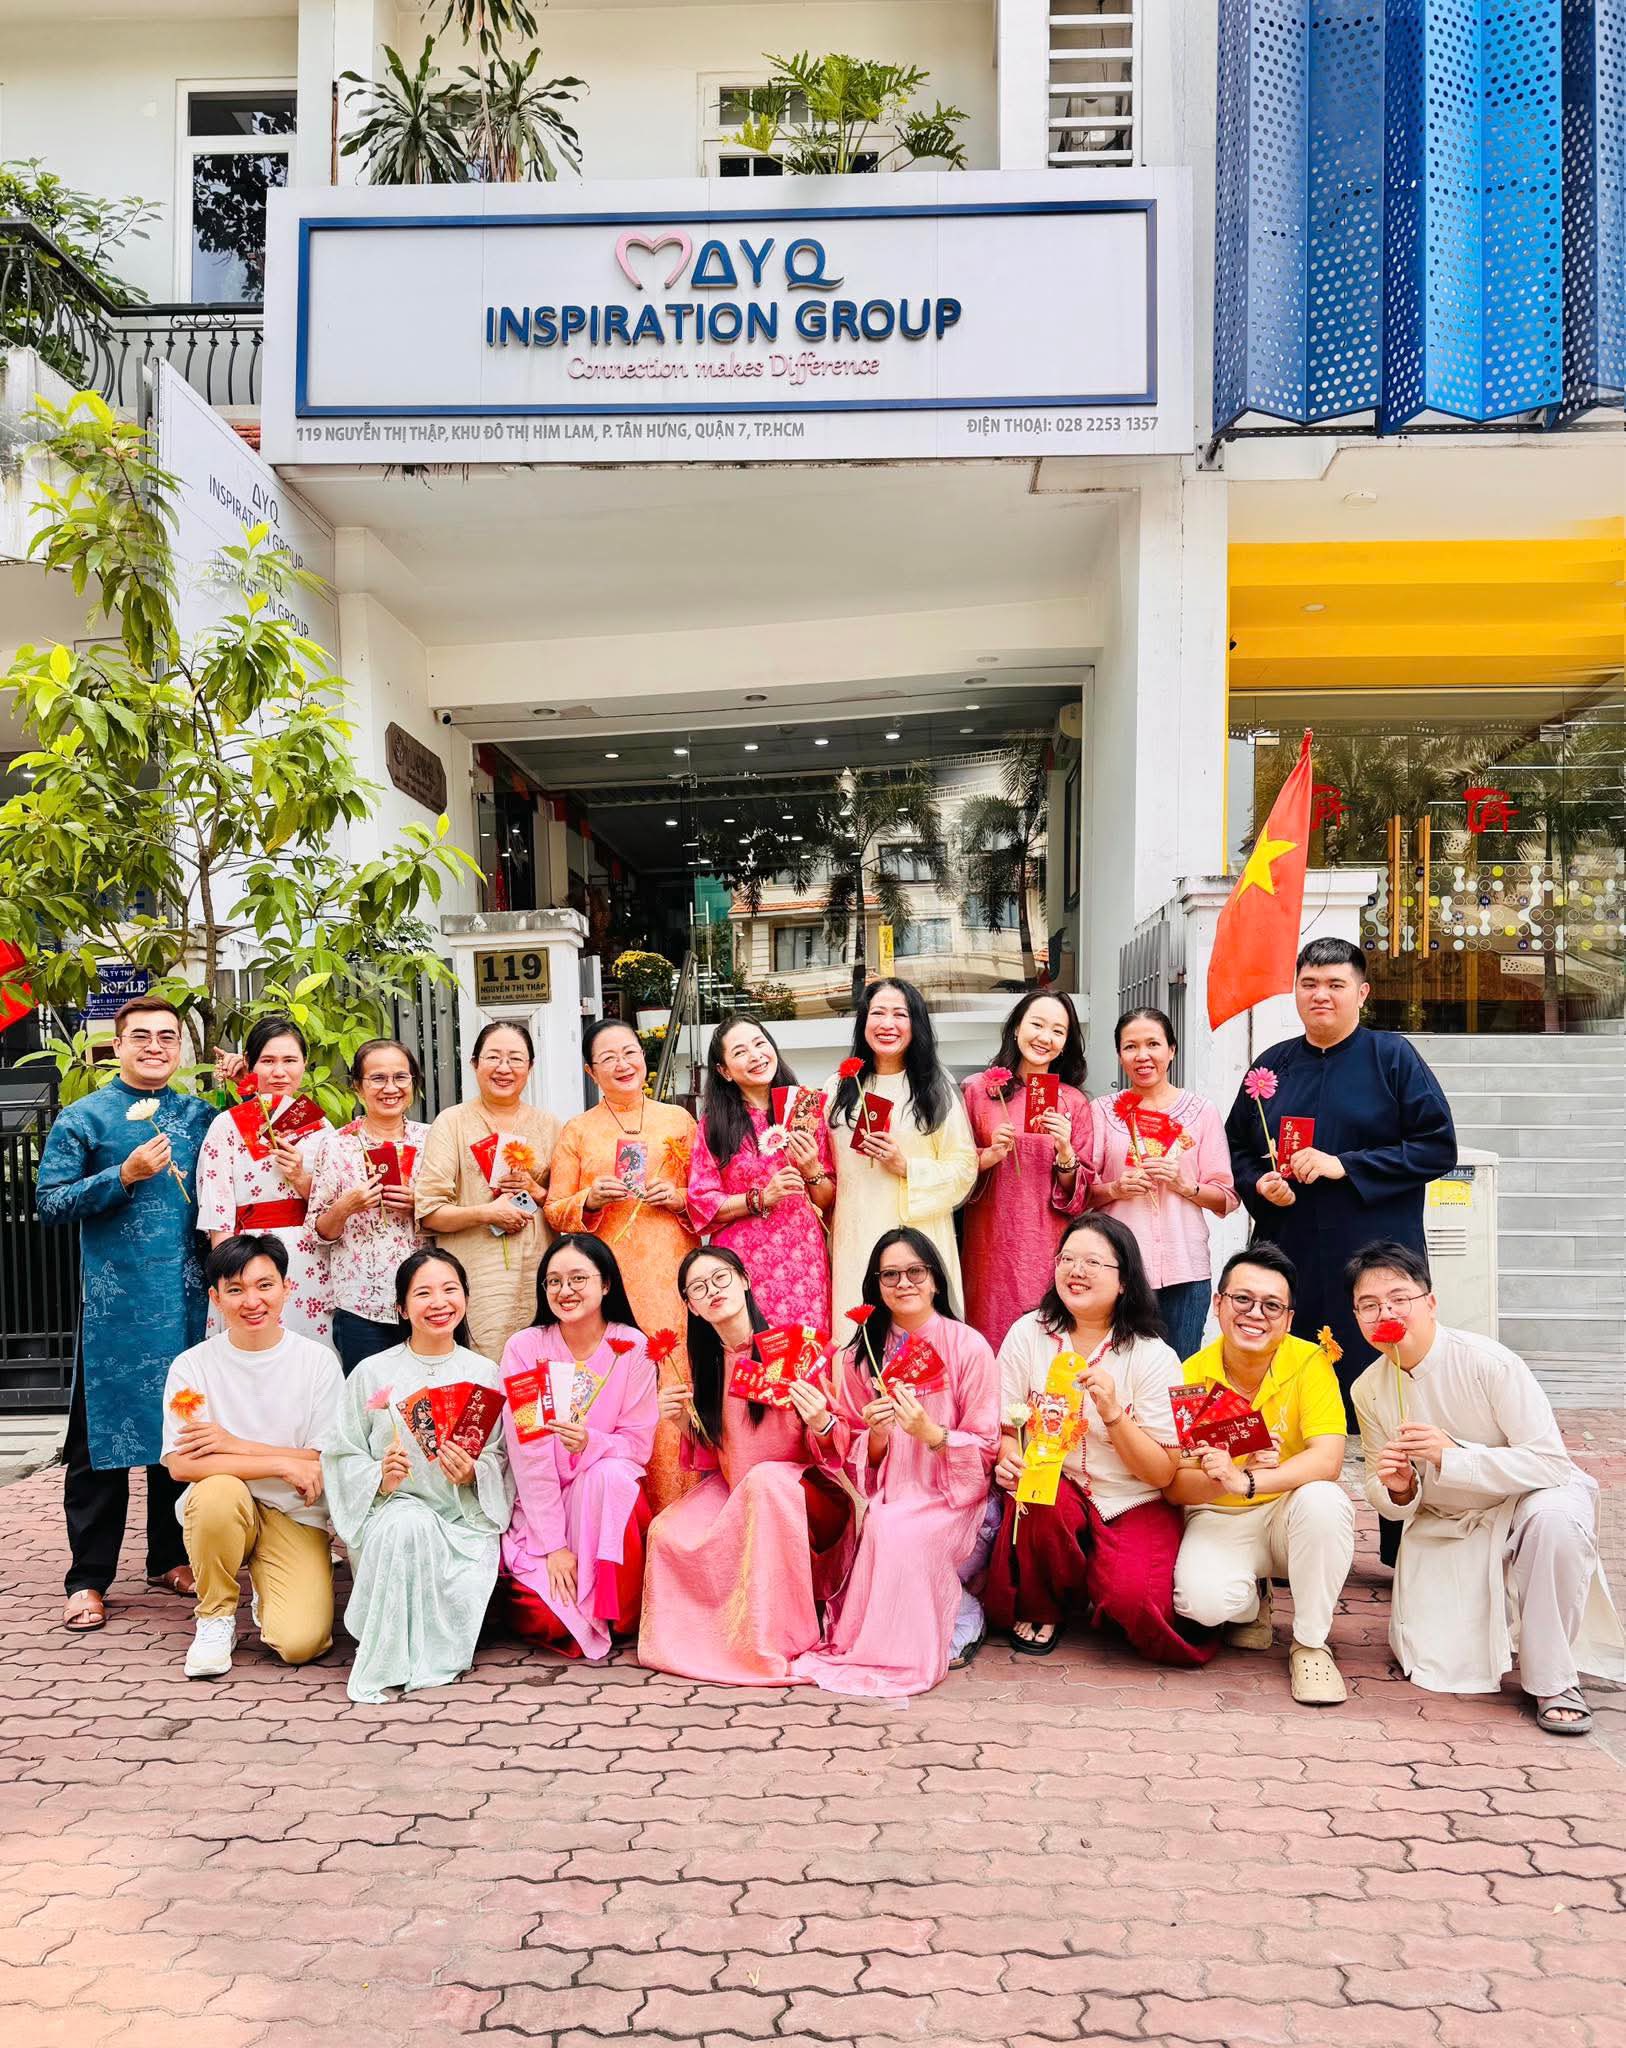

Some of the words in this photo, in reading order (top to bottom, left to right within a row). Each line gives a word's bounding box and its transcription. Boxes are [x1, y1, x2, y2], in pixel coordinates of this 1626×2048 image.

[486, 302, 778, 347] INSPIRATION
[795, 298, 962, 340] GROUP
[567, 355, 689, 379] Connection
[695, 352, 763, 377] makes
[768, 351, 880, 384] Difference
[296, 427, 322, 441] 119
[325, 422, 381, 441] NGUYỄN
[384, 426, 407, 443] THỊ
[409, 424, 449, 443] THẬP,
[452, 425, 480, 440] KHU
[483, 422, 504, 440] ĐÔ
[506, 425, 529, 442] THỊ
[533, 424, 561, 439] HIM
[564, 424, 598, 441] LAM,
[602, 424, 613, 438] P.
[615, 421, 642, 438] TÂN
[646, 422, 692, 440] HƯNG,
[695, 420, 734, 440] QUẬN
[738, 423, 751, 439] 7,
[754, 422, 805, 438] TP.HCM
[967, 416, 1000, 436] ĐIỆN
[1004, 418, 1052, 434] THOẠI:
[1056, 417, 1083, 432] 028
[1087, 417, 1121, 431] 2253
[1126, 417, 1159, 431] 1357
[482, 953, 542, 982] 119
